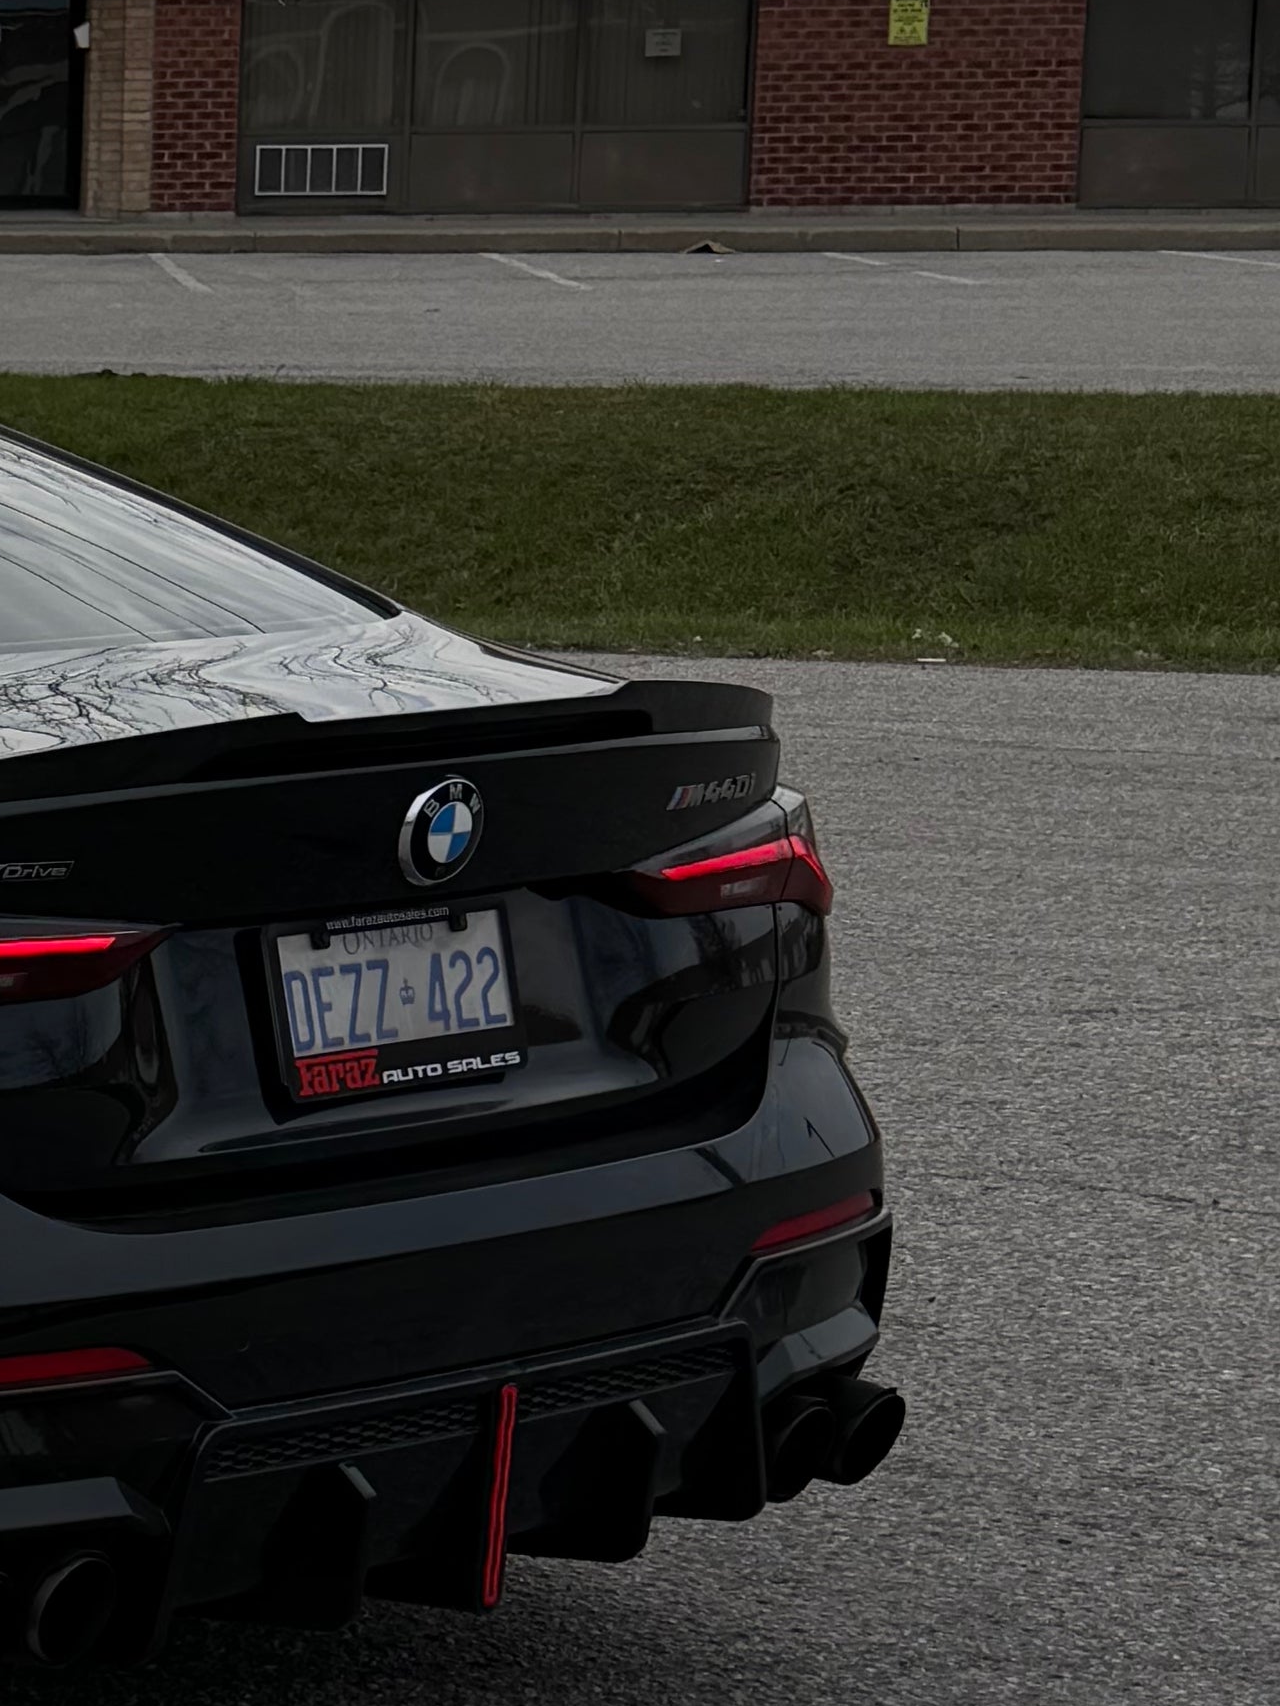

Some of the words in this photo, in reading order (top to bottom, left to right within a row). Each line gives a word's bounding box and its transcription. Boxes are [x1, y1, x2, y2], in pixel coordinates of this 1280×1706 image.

[423, 783, 481, 818] BMW
[342, 922, 433, 955] ONTARIO
[427, 946, 508, 1031] 422
[294, 1047, 382, 1098] Faraz
[382, 1062, 444, 1085] AUTO
[446, 1050, 522, 1075] SALES
